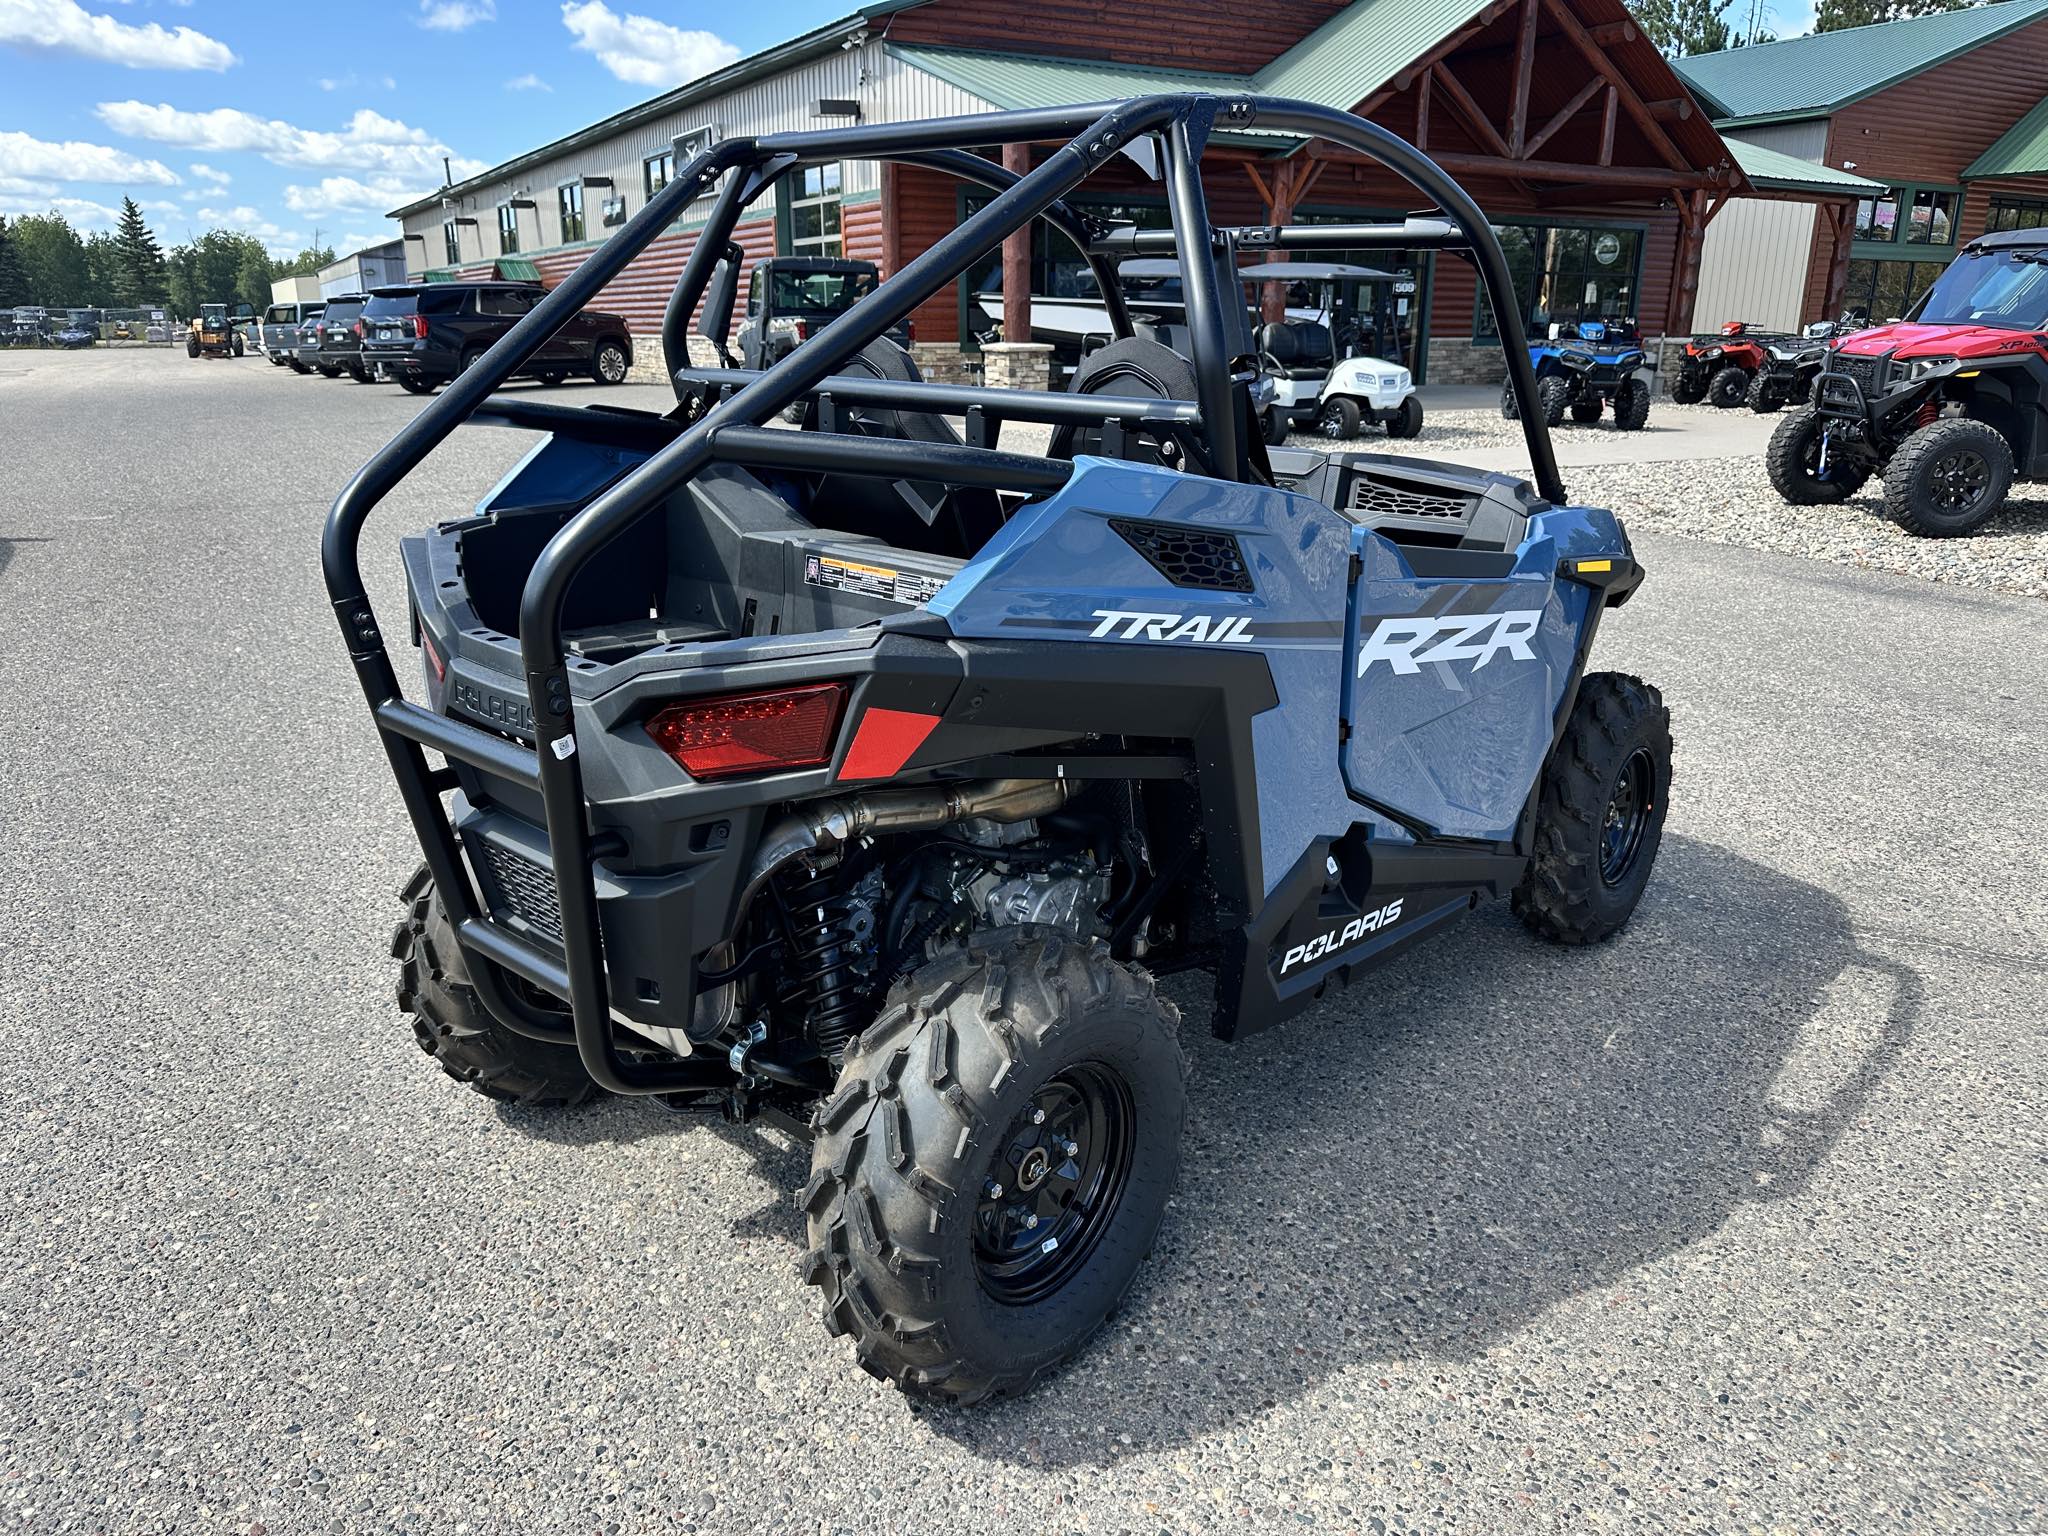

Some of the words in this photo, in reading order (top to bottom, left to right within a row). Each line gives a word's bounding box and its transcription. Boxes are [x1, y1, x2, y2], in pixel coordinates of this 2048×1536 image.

[1395, 282, 1415, 293] 509
[1997, 340, 2024, 351] XP
[1089, 609, 1255, 643] TRAIL
[1357, 609, 1542, 679] RZR
[1279, 897, 1404, 975] POLARIS
